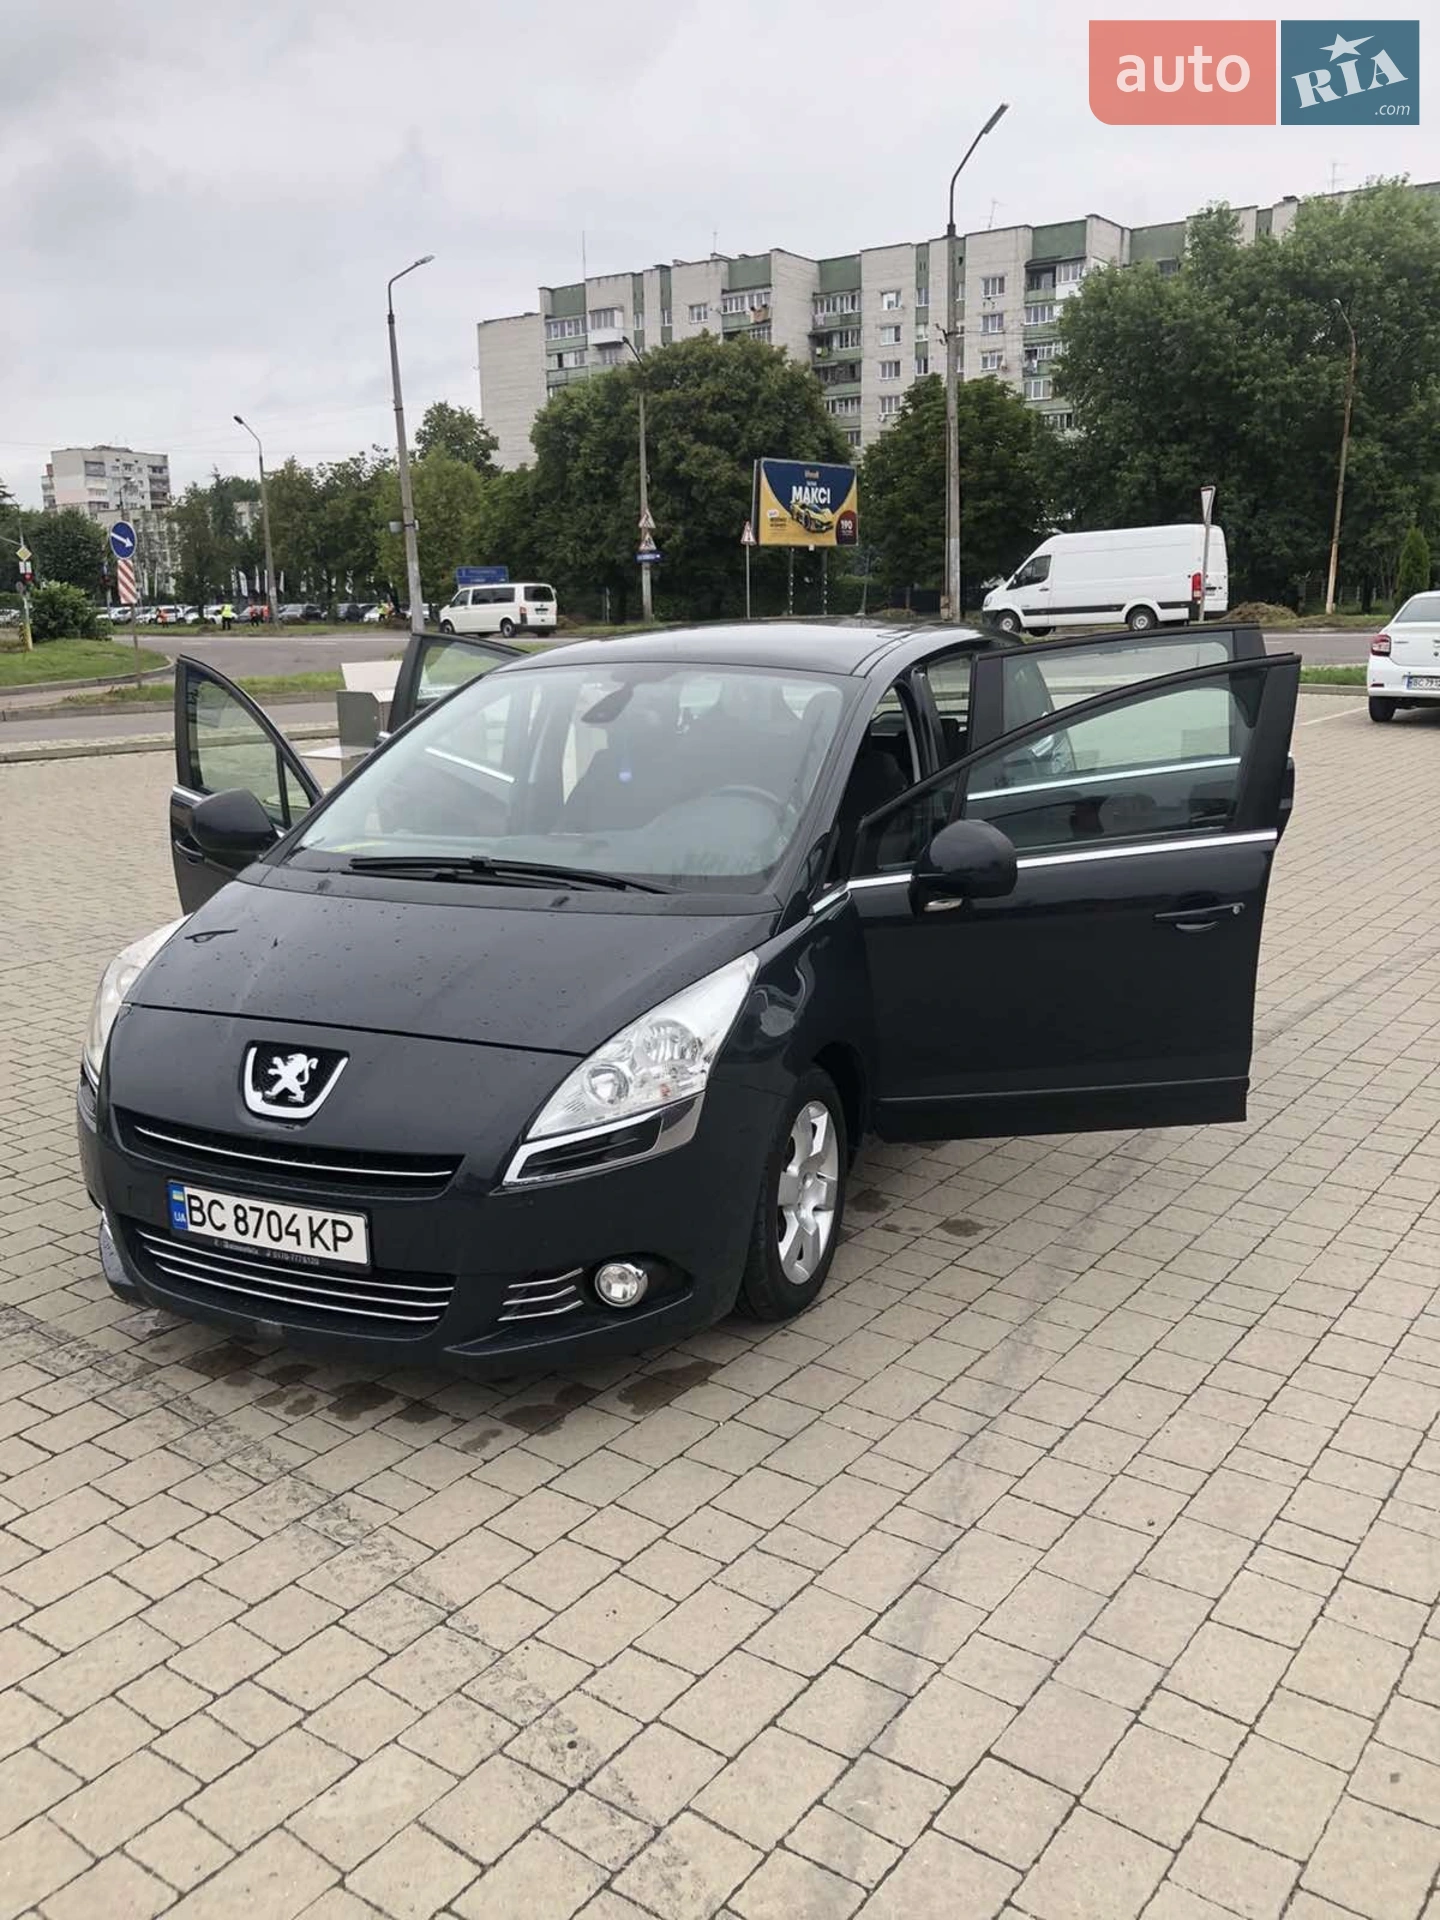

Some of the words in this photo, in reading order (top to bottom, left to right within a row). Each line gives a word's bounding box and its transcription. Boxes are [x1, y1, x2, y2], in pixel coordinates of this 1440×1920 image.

[791, 485, 831, 504] МАКСІ
[174, 1211, 187, 1224] UA
[187, 1194, 227, 1232] BC
[233, 1203, 302, 1247] 8704
[308, 1216, 354, 1253] KP
